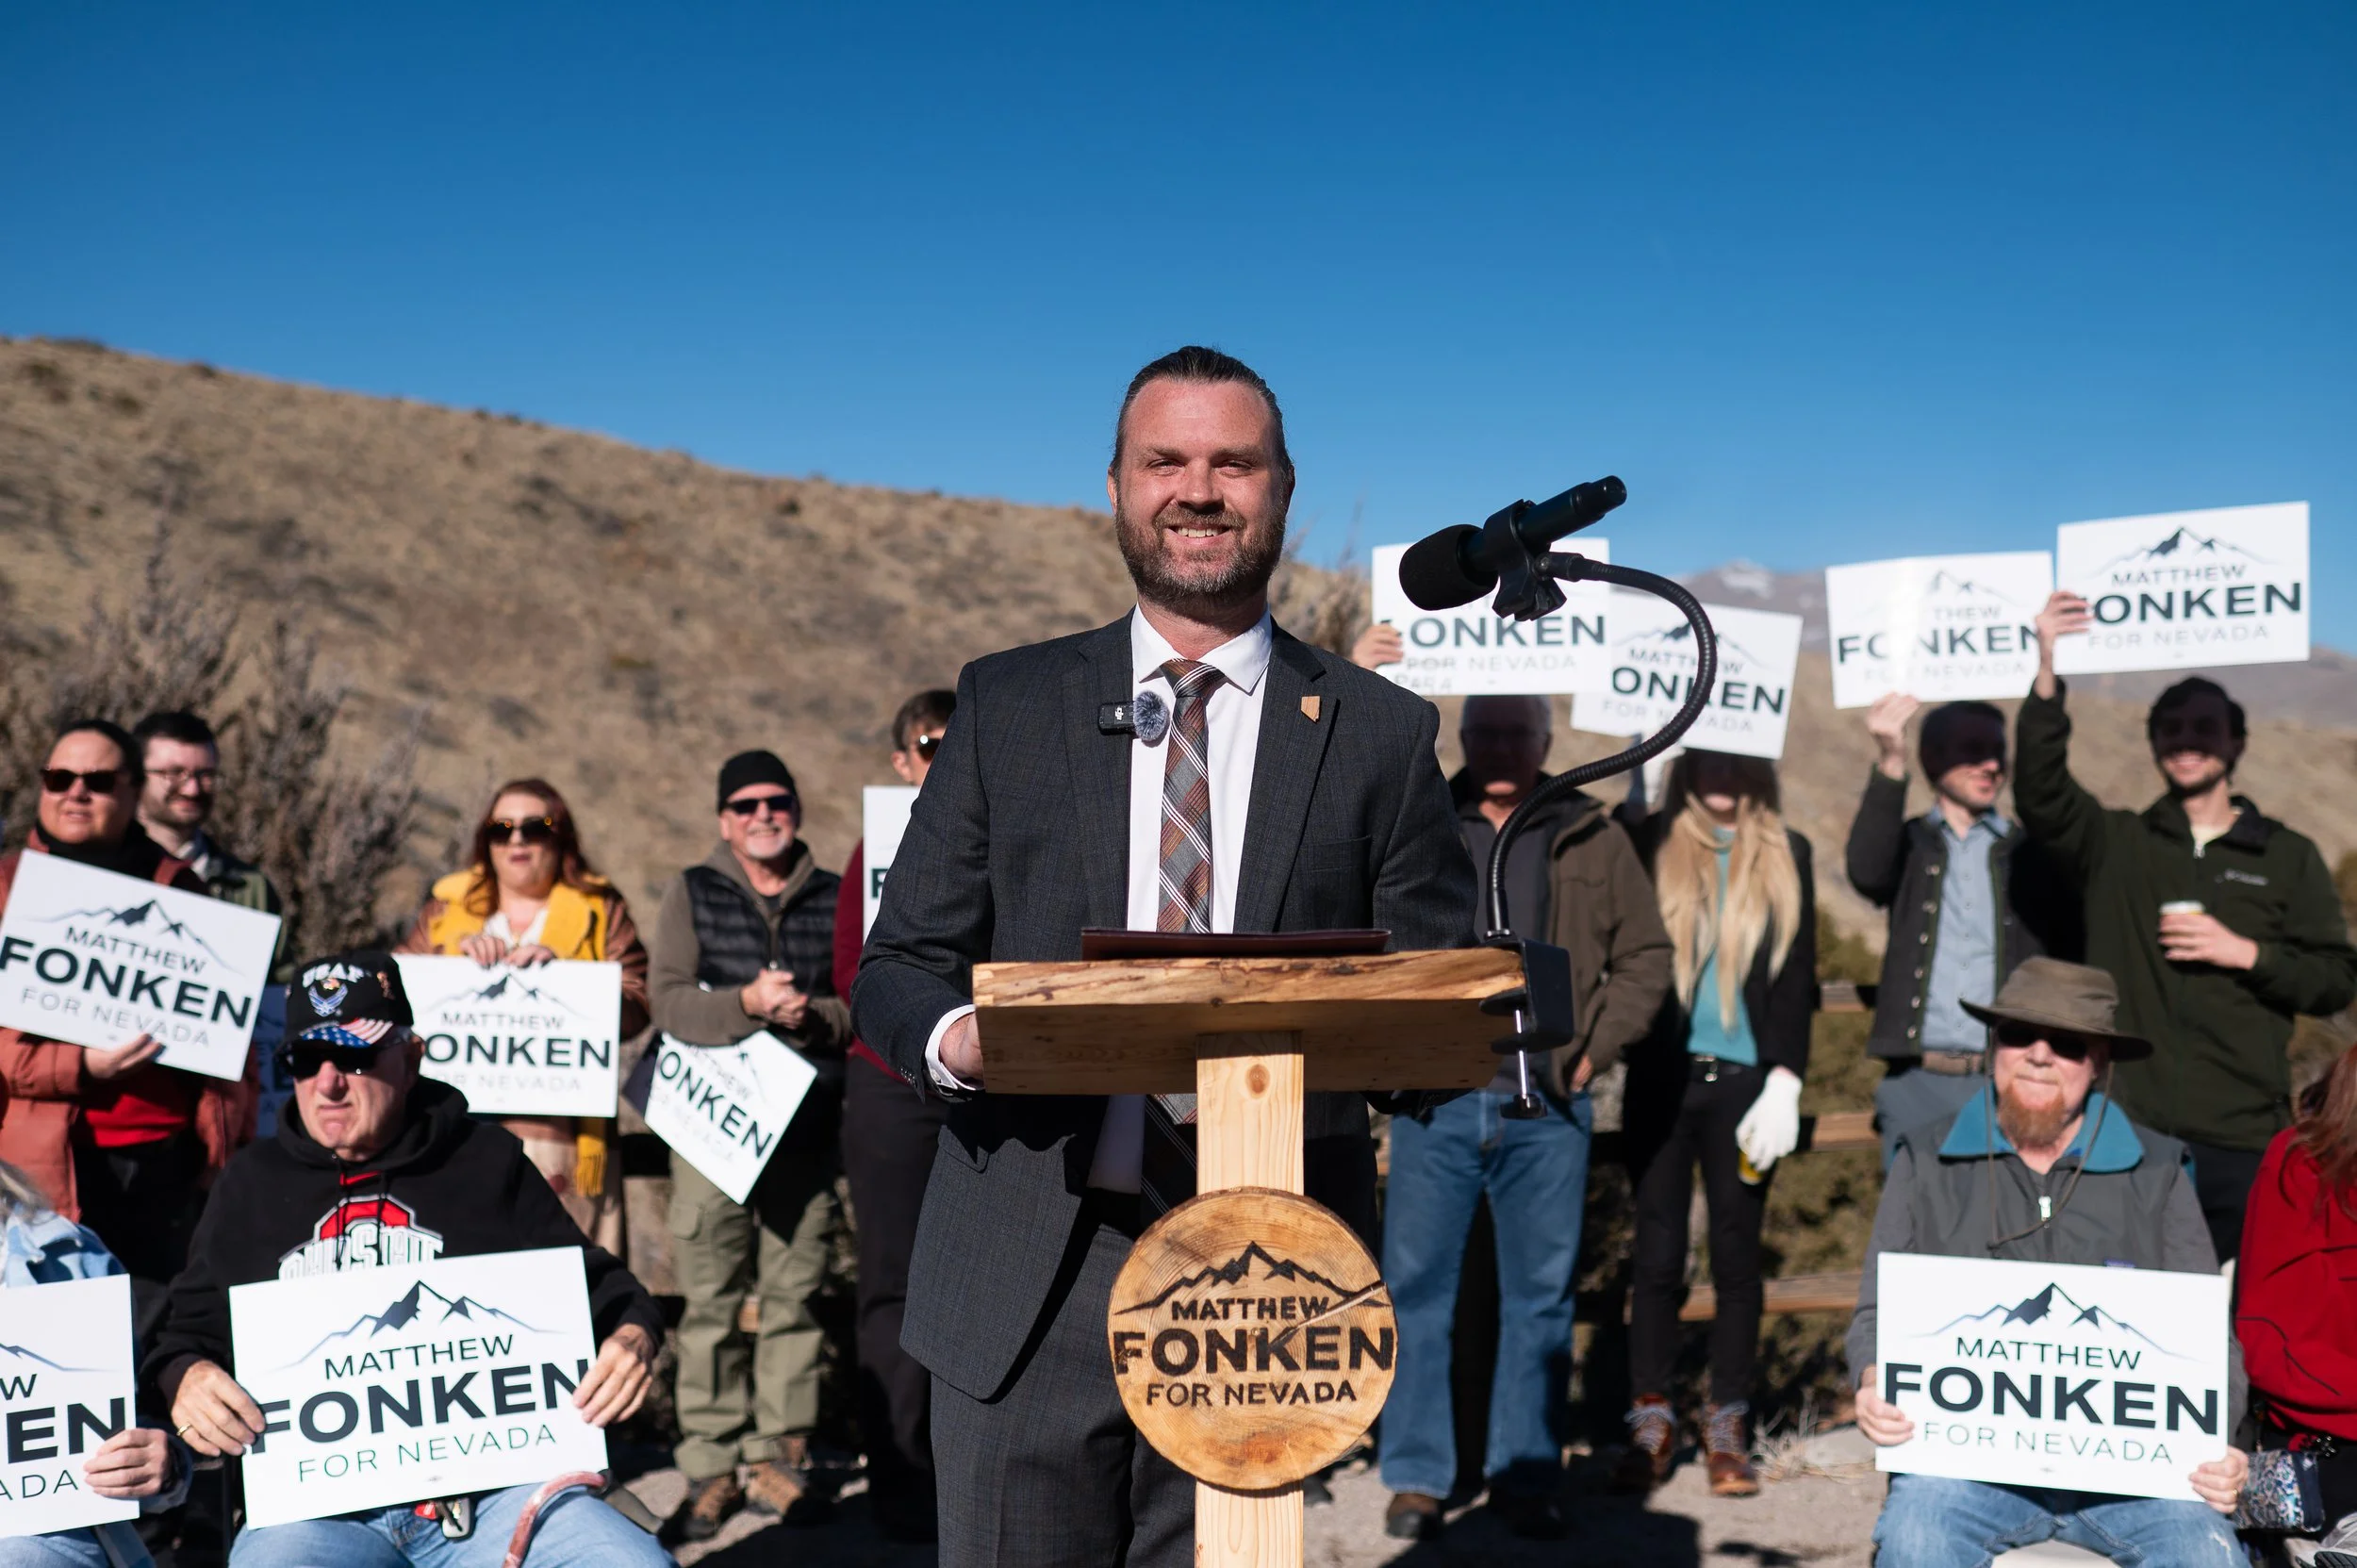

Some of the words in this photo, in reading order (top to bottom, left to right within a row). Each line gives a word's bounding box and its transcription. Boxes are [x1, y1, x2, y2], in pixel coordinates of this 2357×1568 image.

[2112, 563, 2247, 586] MATTHEW
[1935, 605, 2002, 622] THEW
[2094, 582, 2300, 625] ONKEN
[1379, 614, 1606, 648] ONKEN
[2088, 633, 2143, 650] FOR
[2152, 625, 2270, 647] NEVADA
[1467, 654, 1577, 672] NEVADA
[1629, 648, 1745, 675] MATTW
[1604, 700, 1647, 718] FOR
[1612, 666, 1785, 715] ONEN
[65, 925, 207, 975] MATTHEW
[0, 936, 252, 1029] FONKEN
[20, 988, 82, 1016] FOR
[93, 1004, 209, 1047] NEVADA
[441, 1012, 566, 1031] MATTHEW
[424, 1033, 611, 1068] ONKEN
[660, 1050, 773, 1159] ONKEN
[1171, 1296, 1329, 1321] MATTHEW
[325, 1334, 513, 1380] MATTHEW
[1113, 1326, 1394, 1376] FONKEN
[1956, 1336, 2141, 1370] MATTHEW
[251, 1359, 588, 1455] FONKEN
[1146, 1383, 1212, 1407] FOR
[1225, 1380, 1357, 1406] NEVADA
[1886, 1362, 2218, 1436] FONKEN
[299, 1449, 377, 1483] FOR
[399, 1425, 556, 1465] NEVADA
[1924, 1421, 1996, 1447] FOR
[2016, 1431, 2172, 1463] NEVADA
